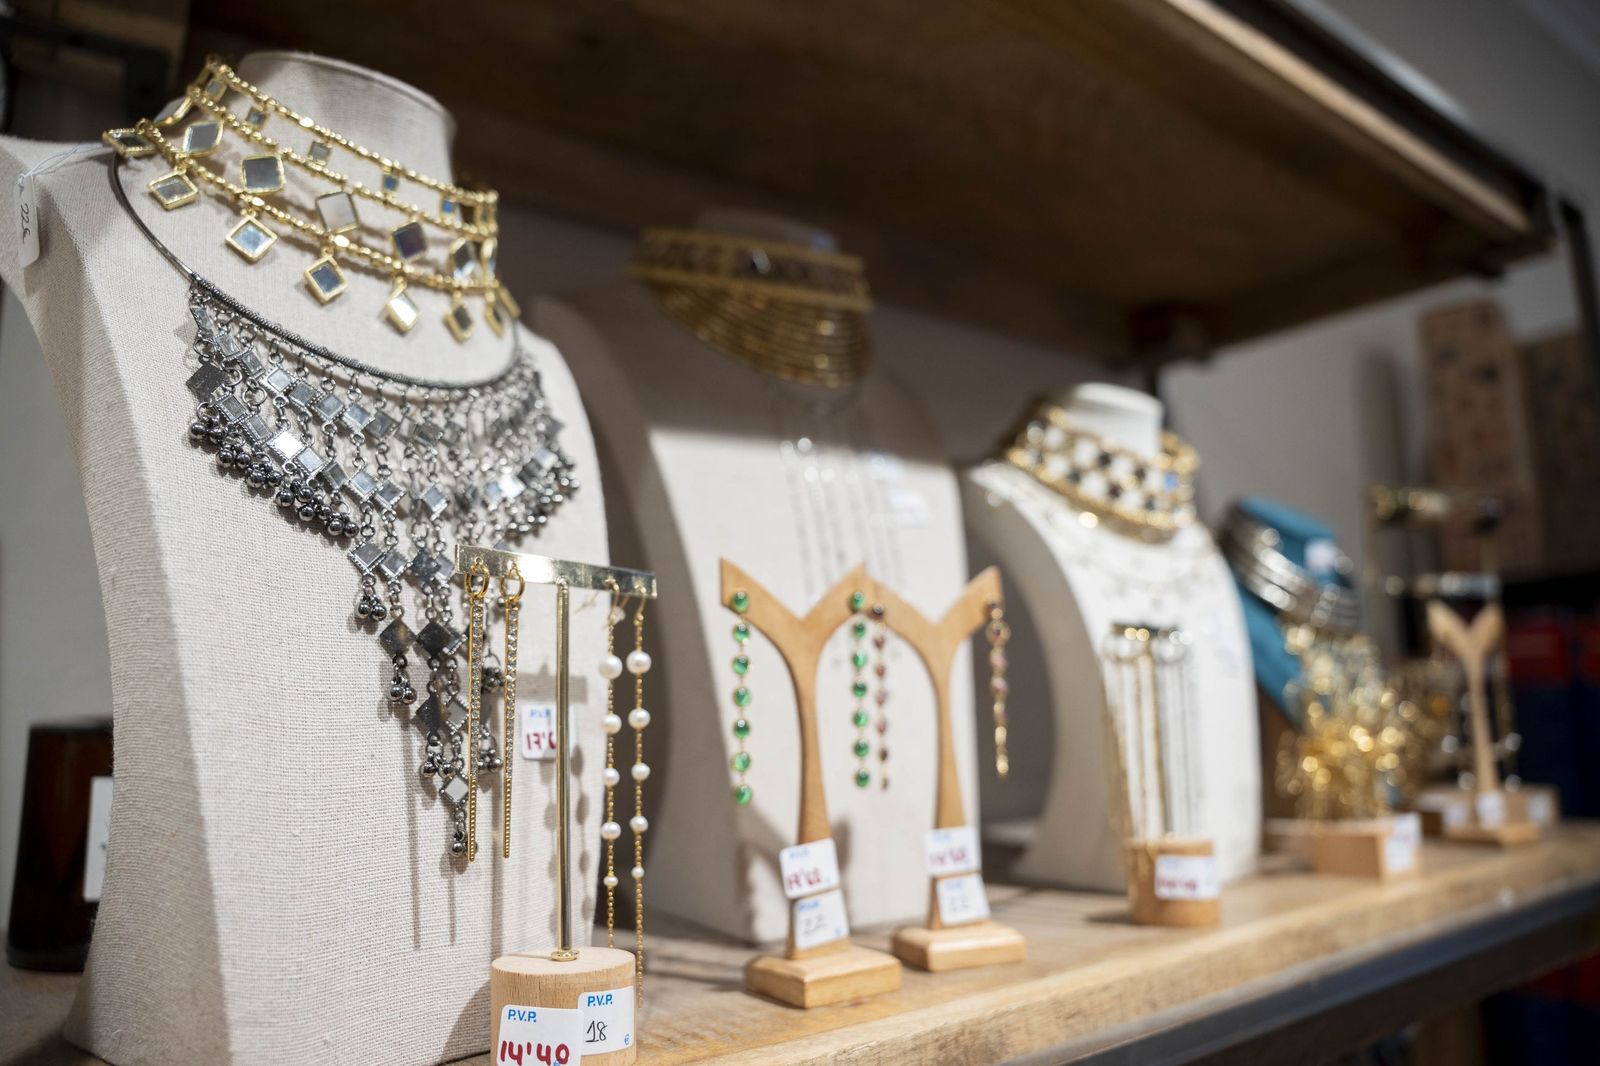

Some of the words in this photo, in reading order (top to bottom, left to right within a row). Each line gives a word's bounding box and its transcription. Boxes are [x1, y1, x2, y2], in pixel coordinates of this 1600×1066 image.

[587, 994, 613, 1007] P.V.P.
[507, 1009, 537, 1023] P.V.P.
[585, 1020, 608, 1043] 18
[500, 1040, 570, 1066] 14'40
